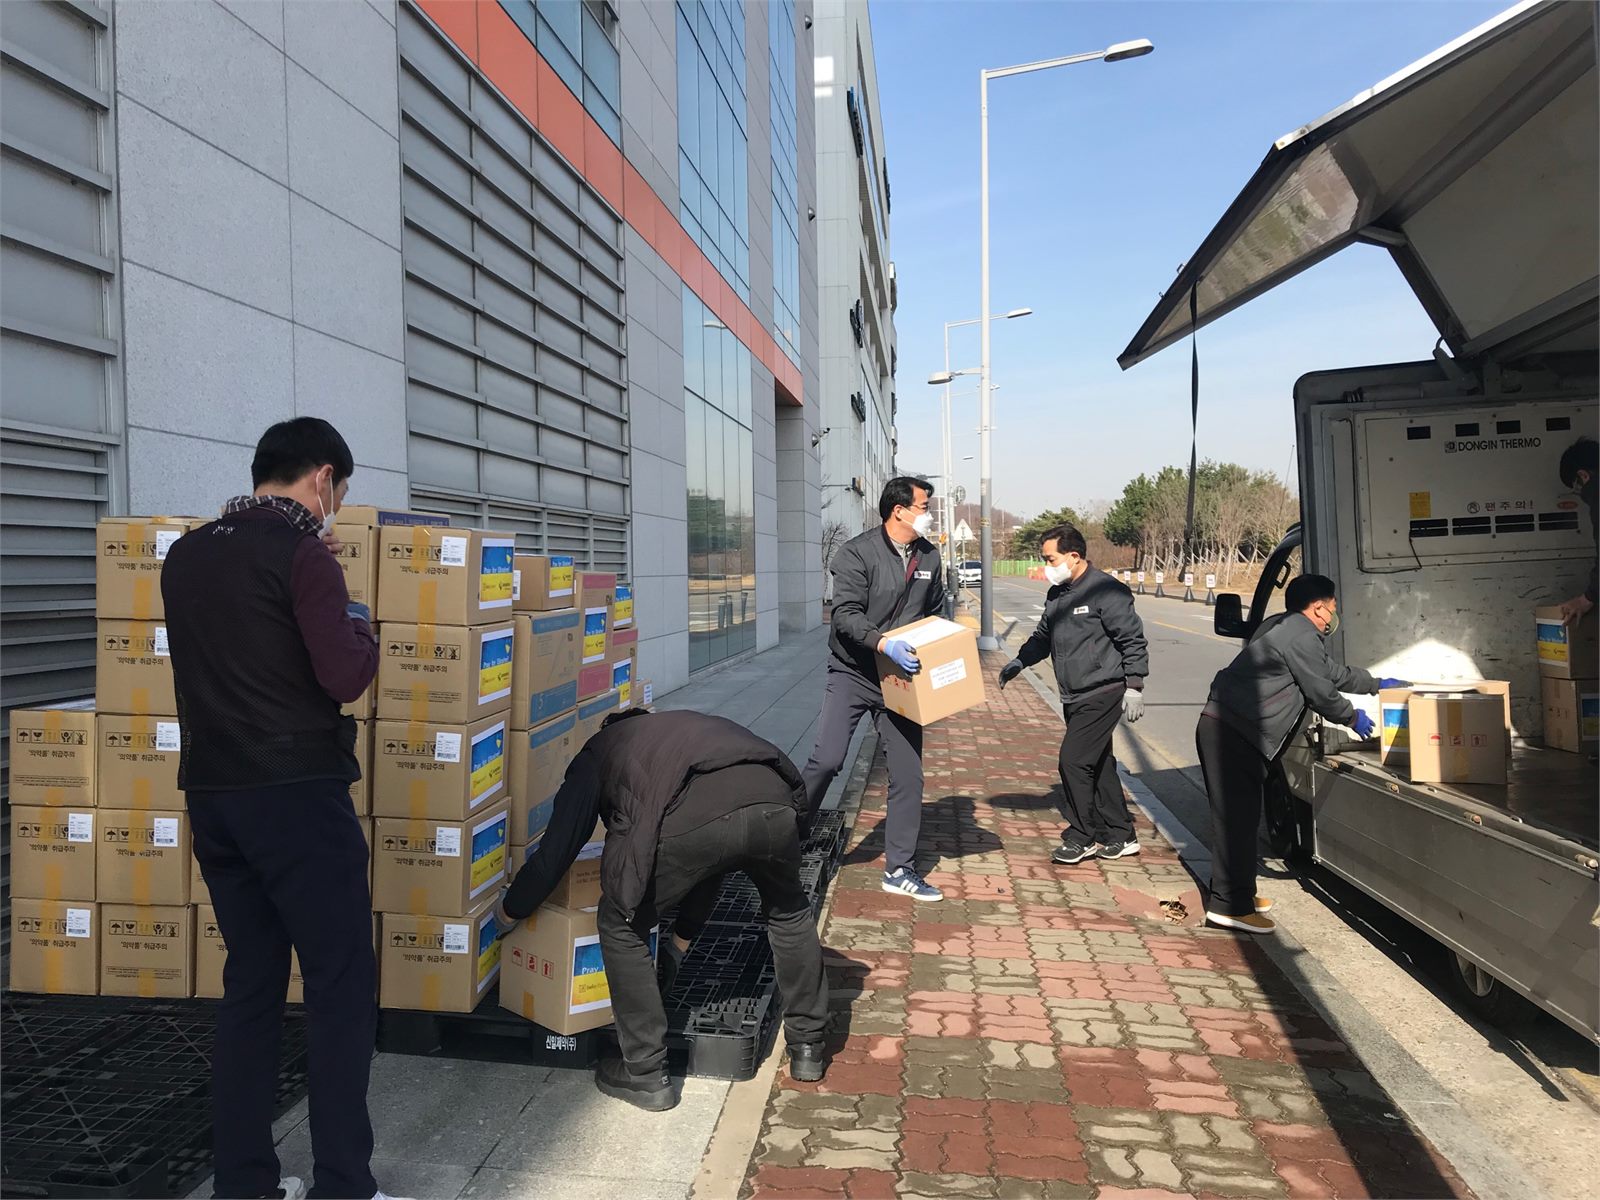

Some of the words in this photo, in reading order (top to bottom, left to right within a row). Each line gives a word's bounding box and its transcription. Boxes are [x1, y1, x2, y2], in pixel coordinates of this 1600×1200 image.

[1458, 440, 1497, 451] DONGIN
[1500, 437, 1541, 449] THERMO
[423, 664, 448, 673] 취급주의
[51, 750, 75, 759] 취급주의
[141, 753, 166, 762] 취급주의
[420, 762, 445, 771] 취급주의
[52, 845, 76, 854] 취급주의
[418, 858, 443, 868] 취급주의
[53, 939, 77, 948] 취급주의
[144, 942, 168, 951] 취급주의
[426, 954, 452, 964] 취급주의
[582, 966, 599, 975] Pray
